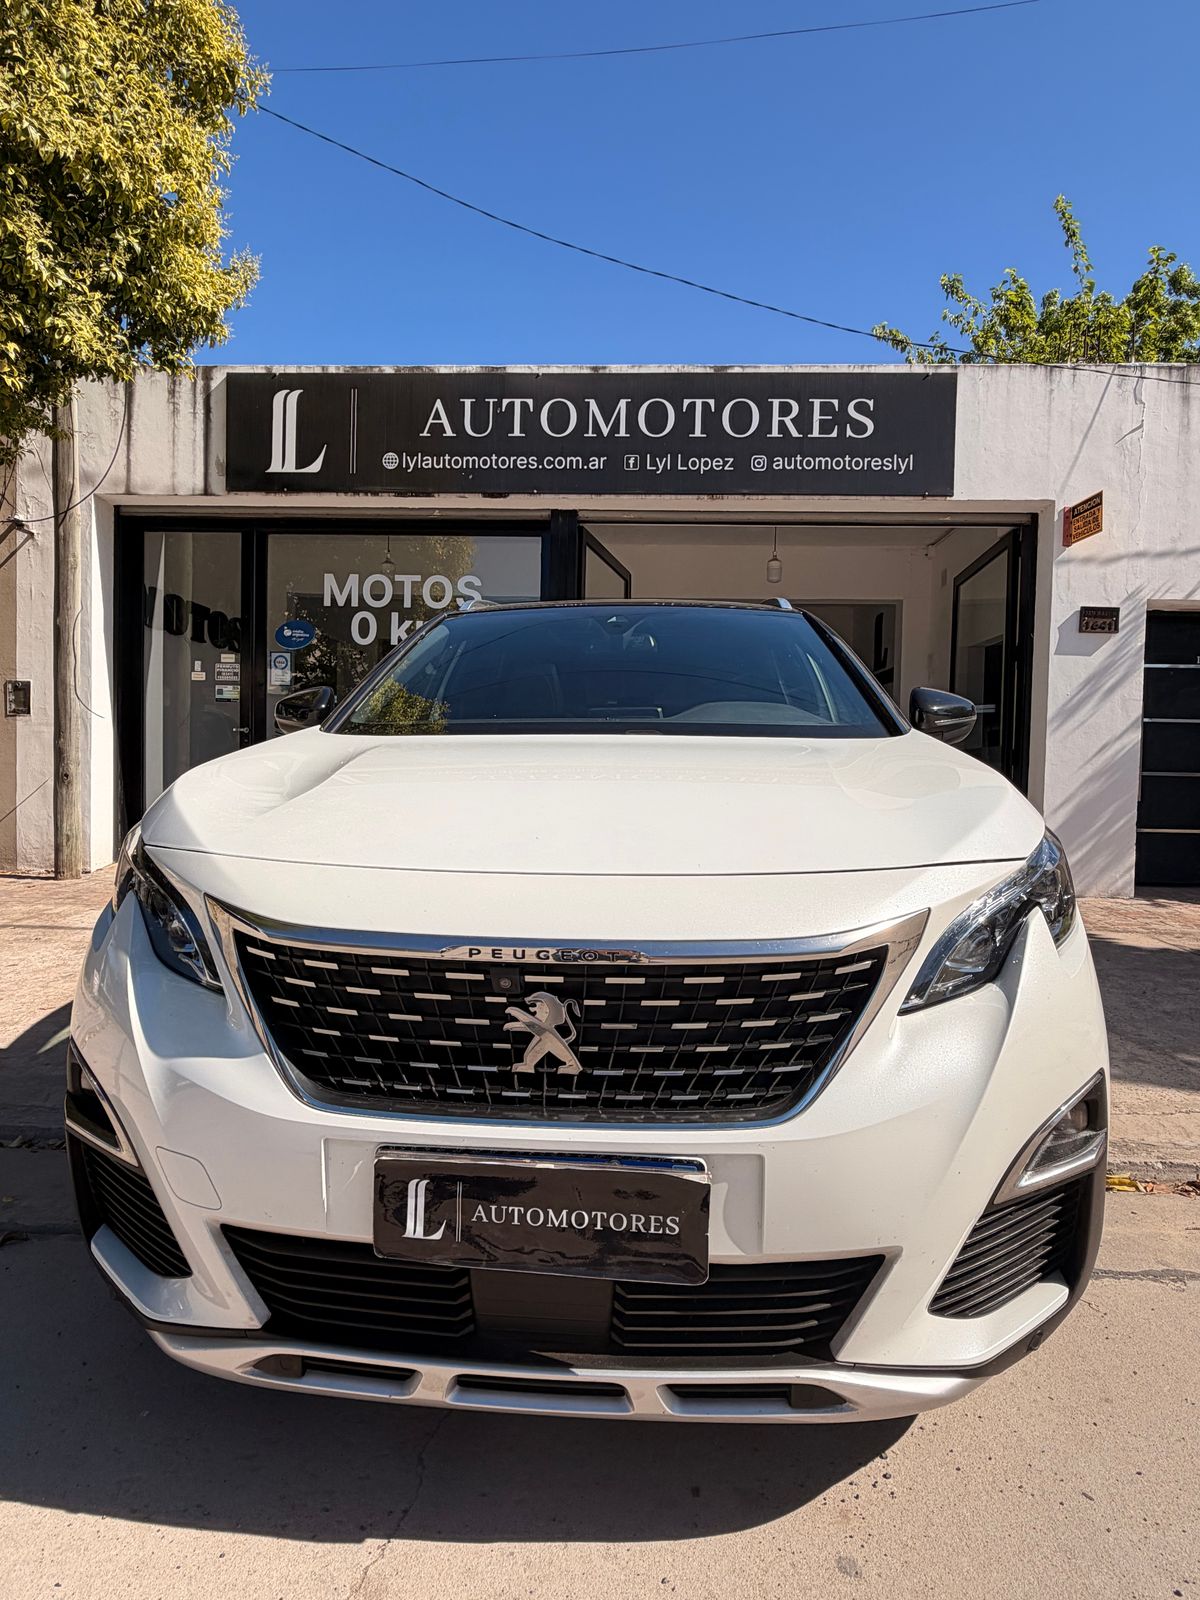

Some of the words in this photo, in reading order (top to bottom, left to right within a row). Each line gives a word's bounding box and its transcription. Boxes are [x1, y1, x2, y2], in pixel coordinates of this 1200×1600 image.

[419, 398, 876, 439] AUTOMOTORES
[402, 452, 607, 473] lylautomotores.com.ar
[646, 454, 671, 475] Lyl
[677, 454, 734, 475] Lopez
[772, 454, 914, 475] automotoreslyl
[323, 573, 482, 609] MOTOS
[390, 612, 427, 646] k
[468, 948, 620, 962] PEUGEOT
[471, 1204, 680, 1236] AUTOMOTORES
